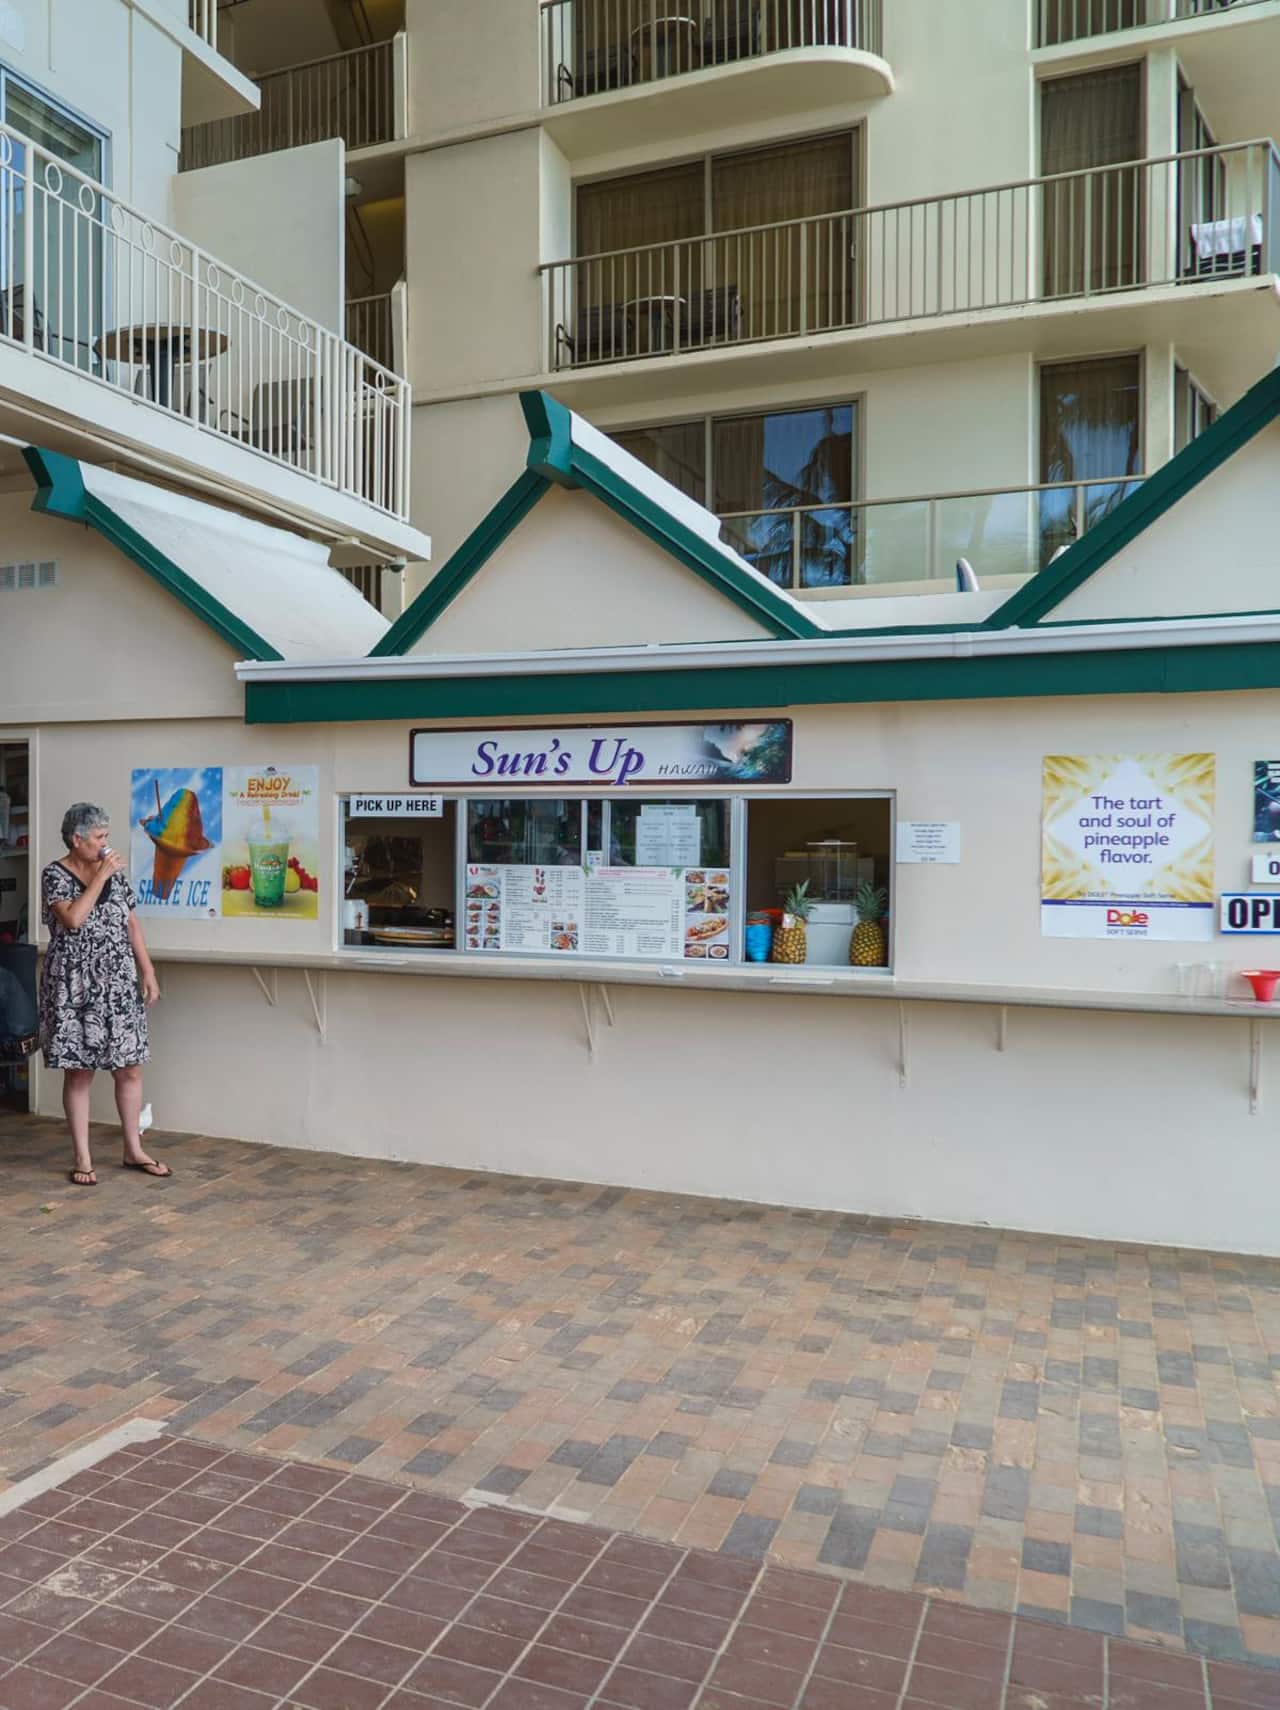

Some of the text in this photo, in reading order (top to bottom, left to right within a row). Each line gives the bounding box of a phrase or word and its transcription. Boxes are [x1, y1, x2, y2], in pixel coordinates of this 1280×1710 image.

[471, 738, 645, 785] Sun's Up
[247, 777, 291, 791] ENJOY
[356, 800, 437, 812] PICK UP HERE
[1091, 796, 1163, 810] The tart
[1079, 813, 1176, 828] and soul of
[1084, 832, 1169, 849] pineapple
[1100, 848, 1152, 864] flavor.
[186, 880, 211, 906] ICE
[1107, 909, 1149, 926] Dole
